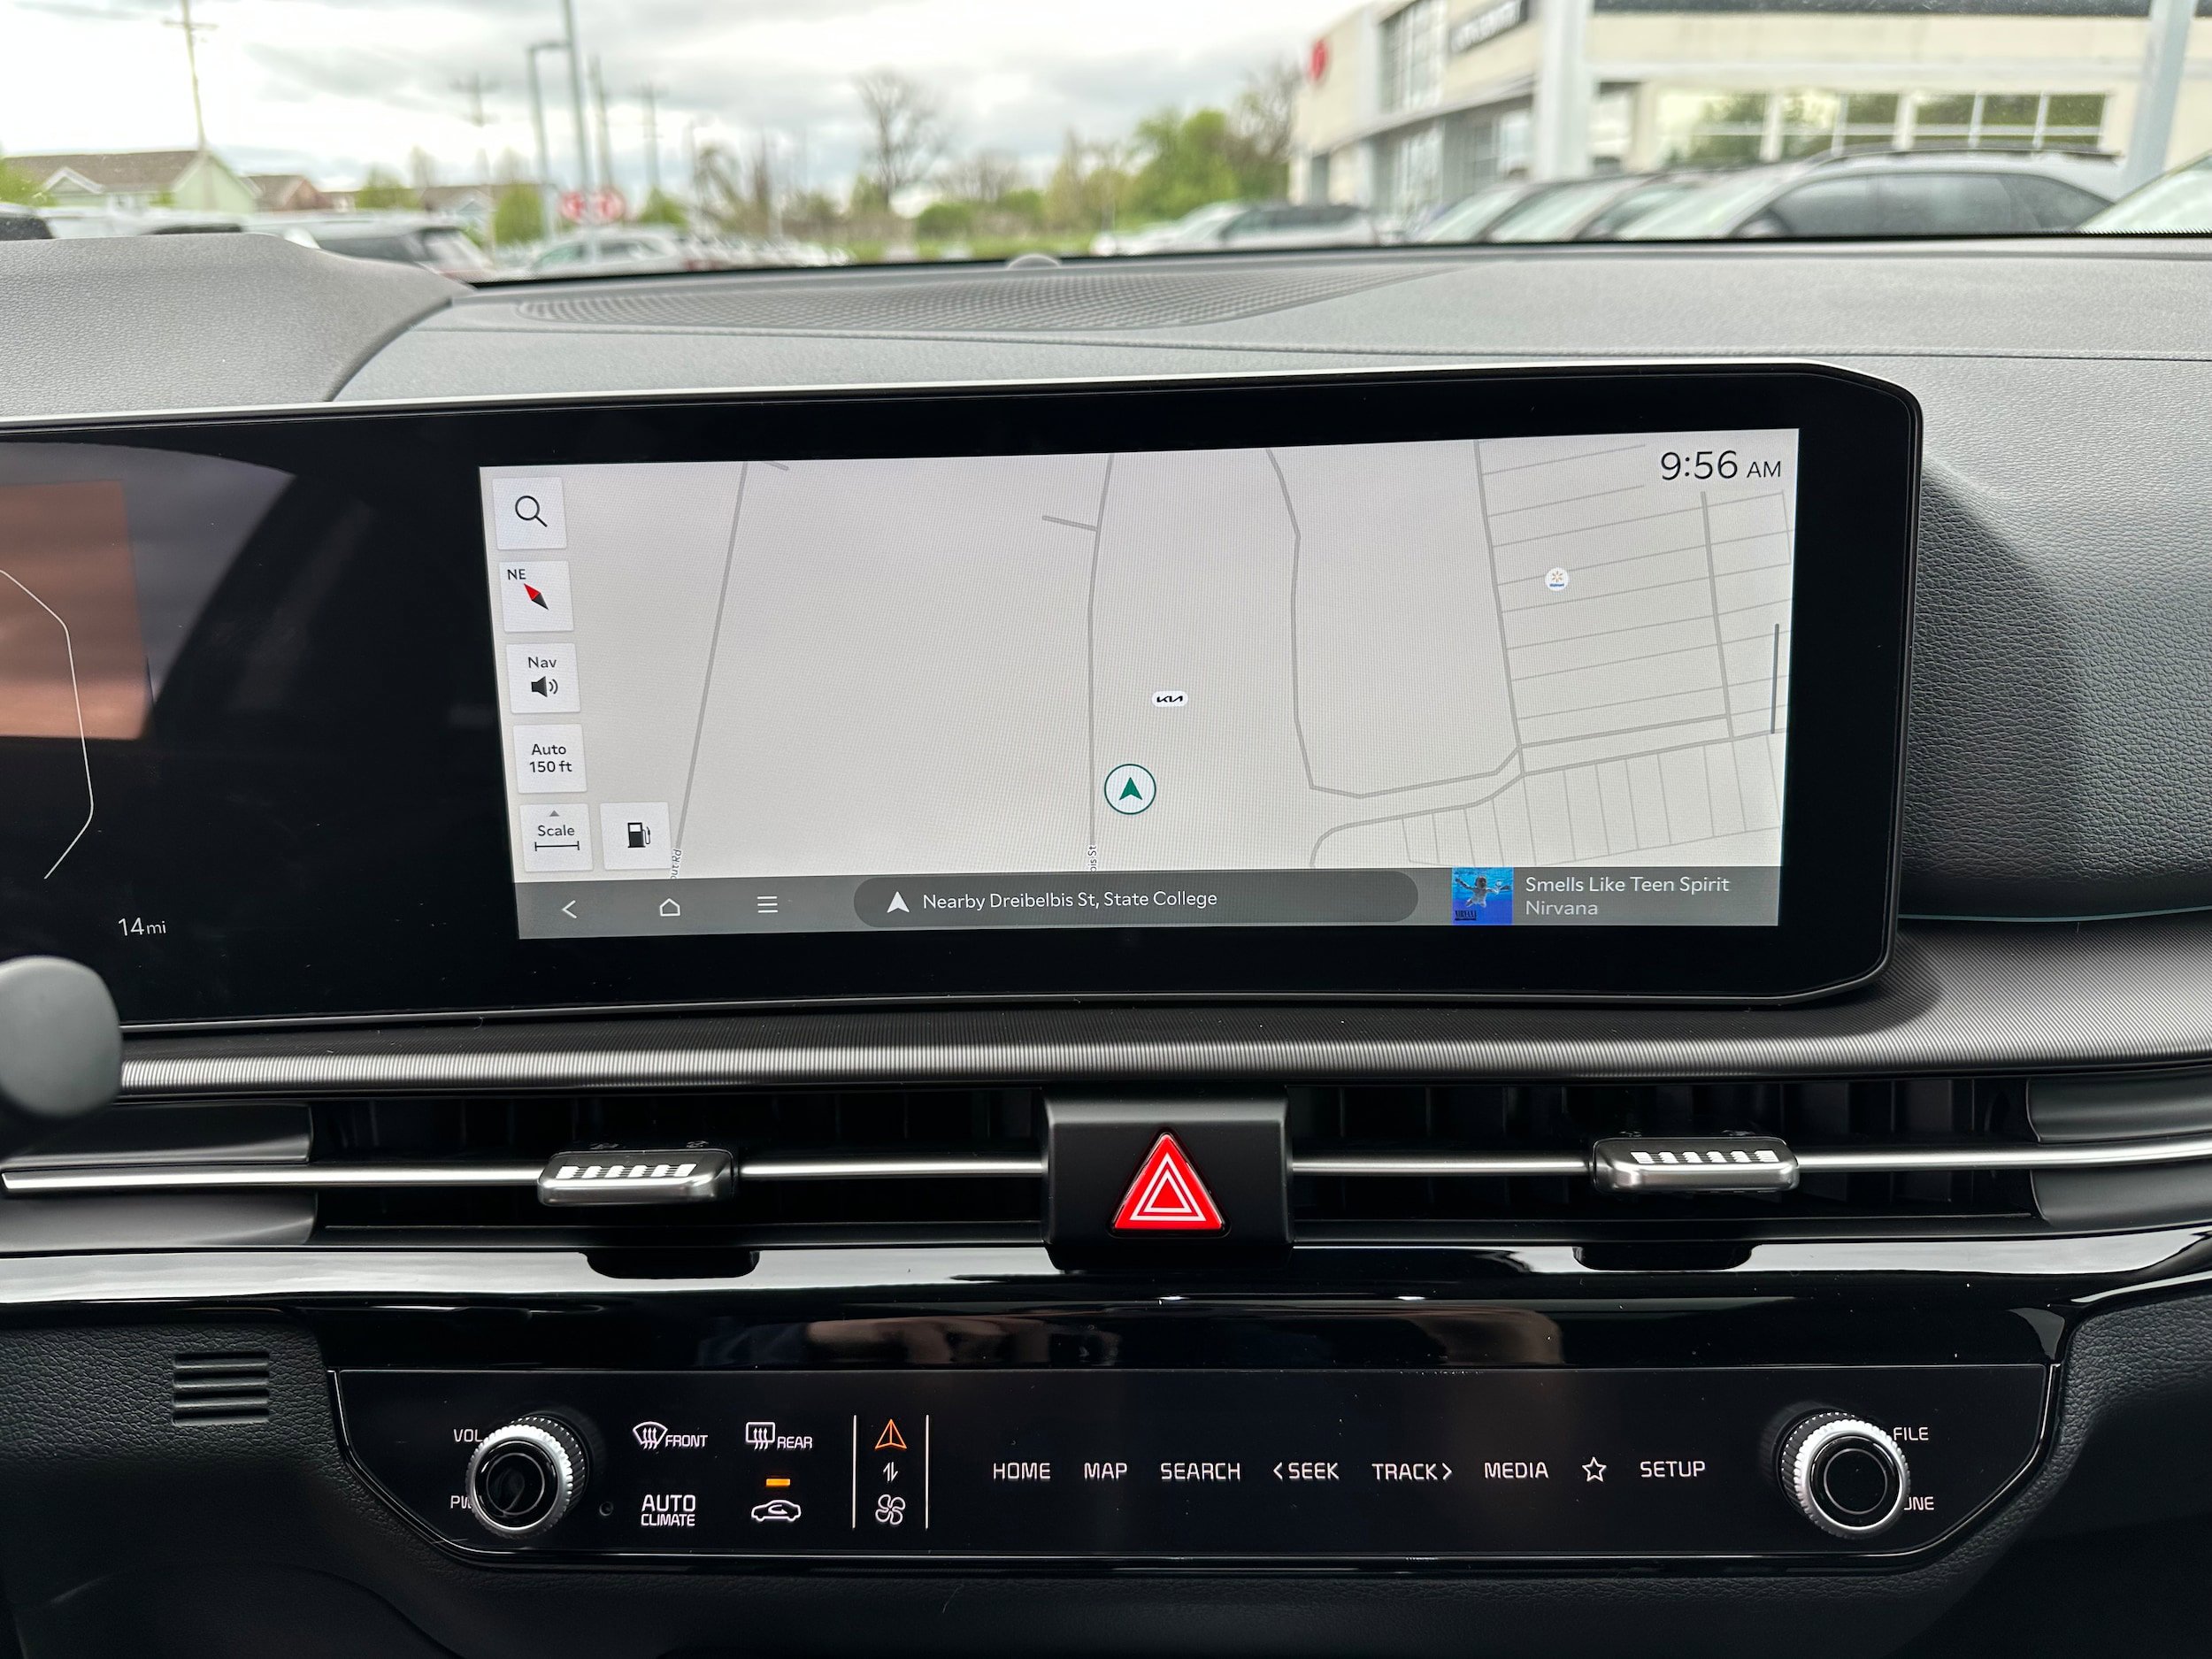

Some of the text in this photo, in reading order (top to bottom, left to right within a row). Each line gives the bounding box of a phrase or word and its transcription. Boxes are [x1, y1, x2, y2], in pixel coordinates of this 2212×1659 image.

[1660, 449, 1781, 481] 9:56 AM
[507, 568, 526, 580] NE
[527, 657, 557, 669] Nav
[531, 743, 567, 756] Auto
[529, 760, 573, 773] 150 ft
[537, 824, 576, 837] Scale
[672, 849, 682, 863] Rd
[1087, 845, 1097, 856] St
[1525, 876, 1730, 895] Smells Like Teen Spirit
[923, 890, 1218, 911] Nearby Dreibelbis St, State College
[1525, 900, 1599, 916] Nirvana
[453, 1428, 483, 1442] VOL
[664, 1434, 709, 1448] FRONT
[1893, 1426, 1929, 1441] FILE
[777, 1436, 813, 1449] REAR
[993, 1462, 1051, 1480] HOME
[1084, 1462, 1128, 1480] MAP
[1160, 1462, 1240, 1480] SEARCH
[1484, 1461, 1549, 1479] MEDIA
[1640, 1460, 1706, 1478] SETUP
[449, 1494, 472, 1509] PW
[641, 1494, 696, 1512] AUTO
[641, 1513, 695, 1527] CLIMATE
